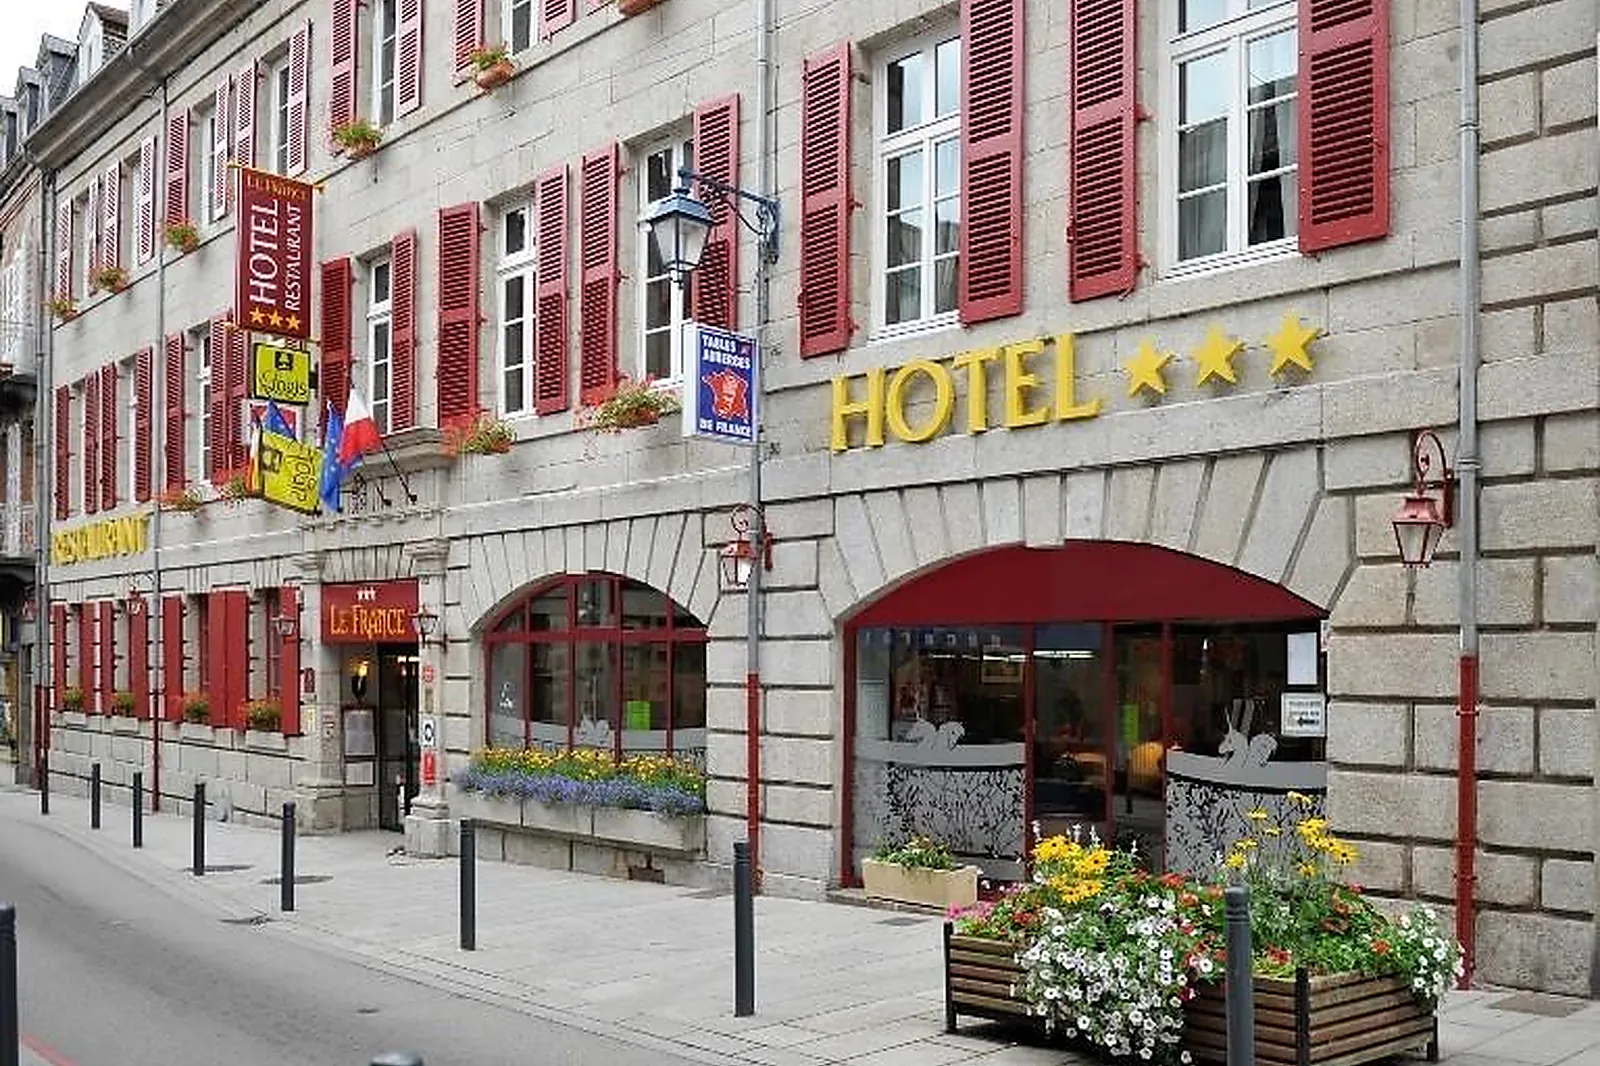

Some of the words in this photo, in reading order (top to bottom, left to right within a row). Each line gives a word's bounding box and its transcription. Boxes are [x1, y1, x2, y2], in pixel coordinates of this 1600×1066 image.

[249, 199, 278, 306] HOTEL
[285, 201, 301, 311] RESTAURANT
[832, 333, 1101, 453] HOTEL
